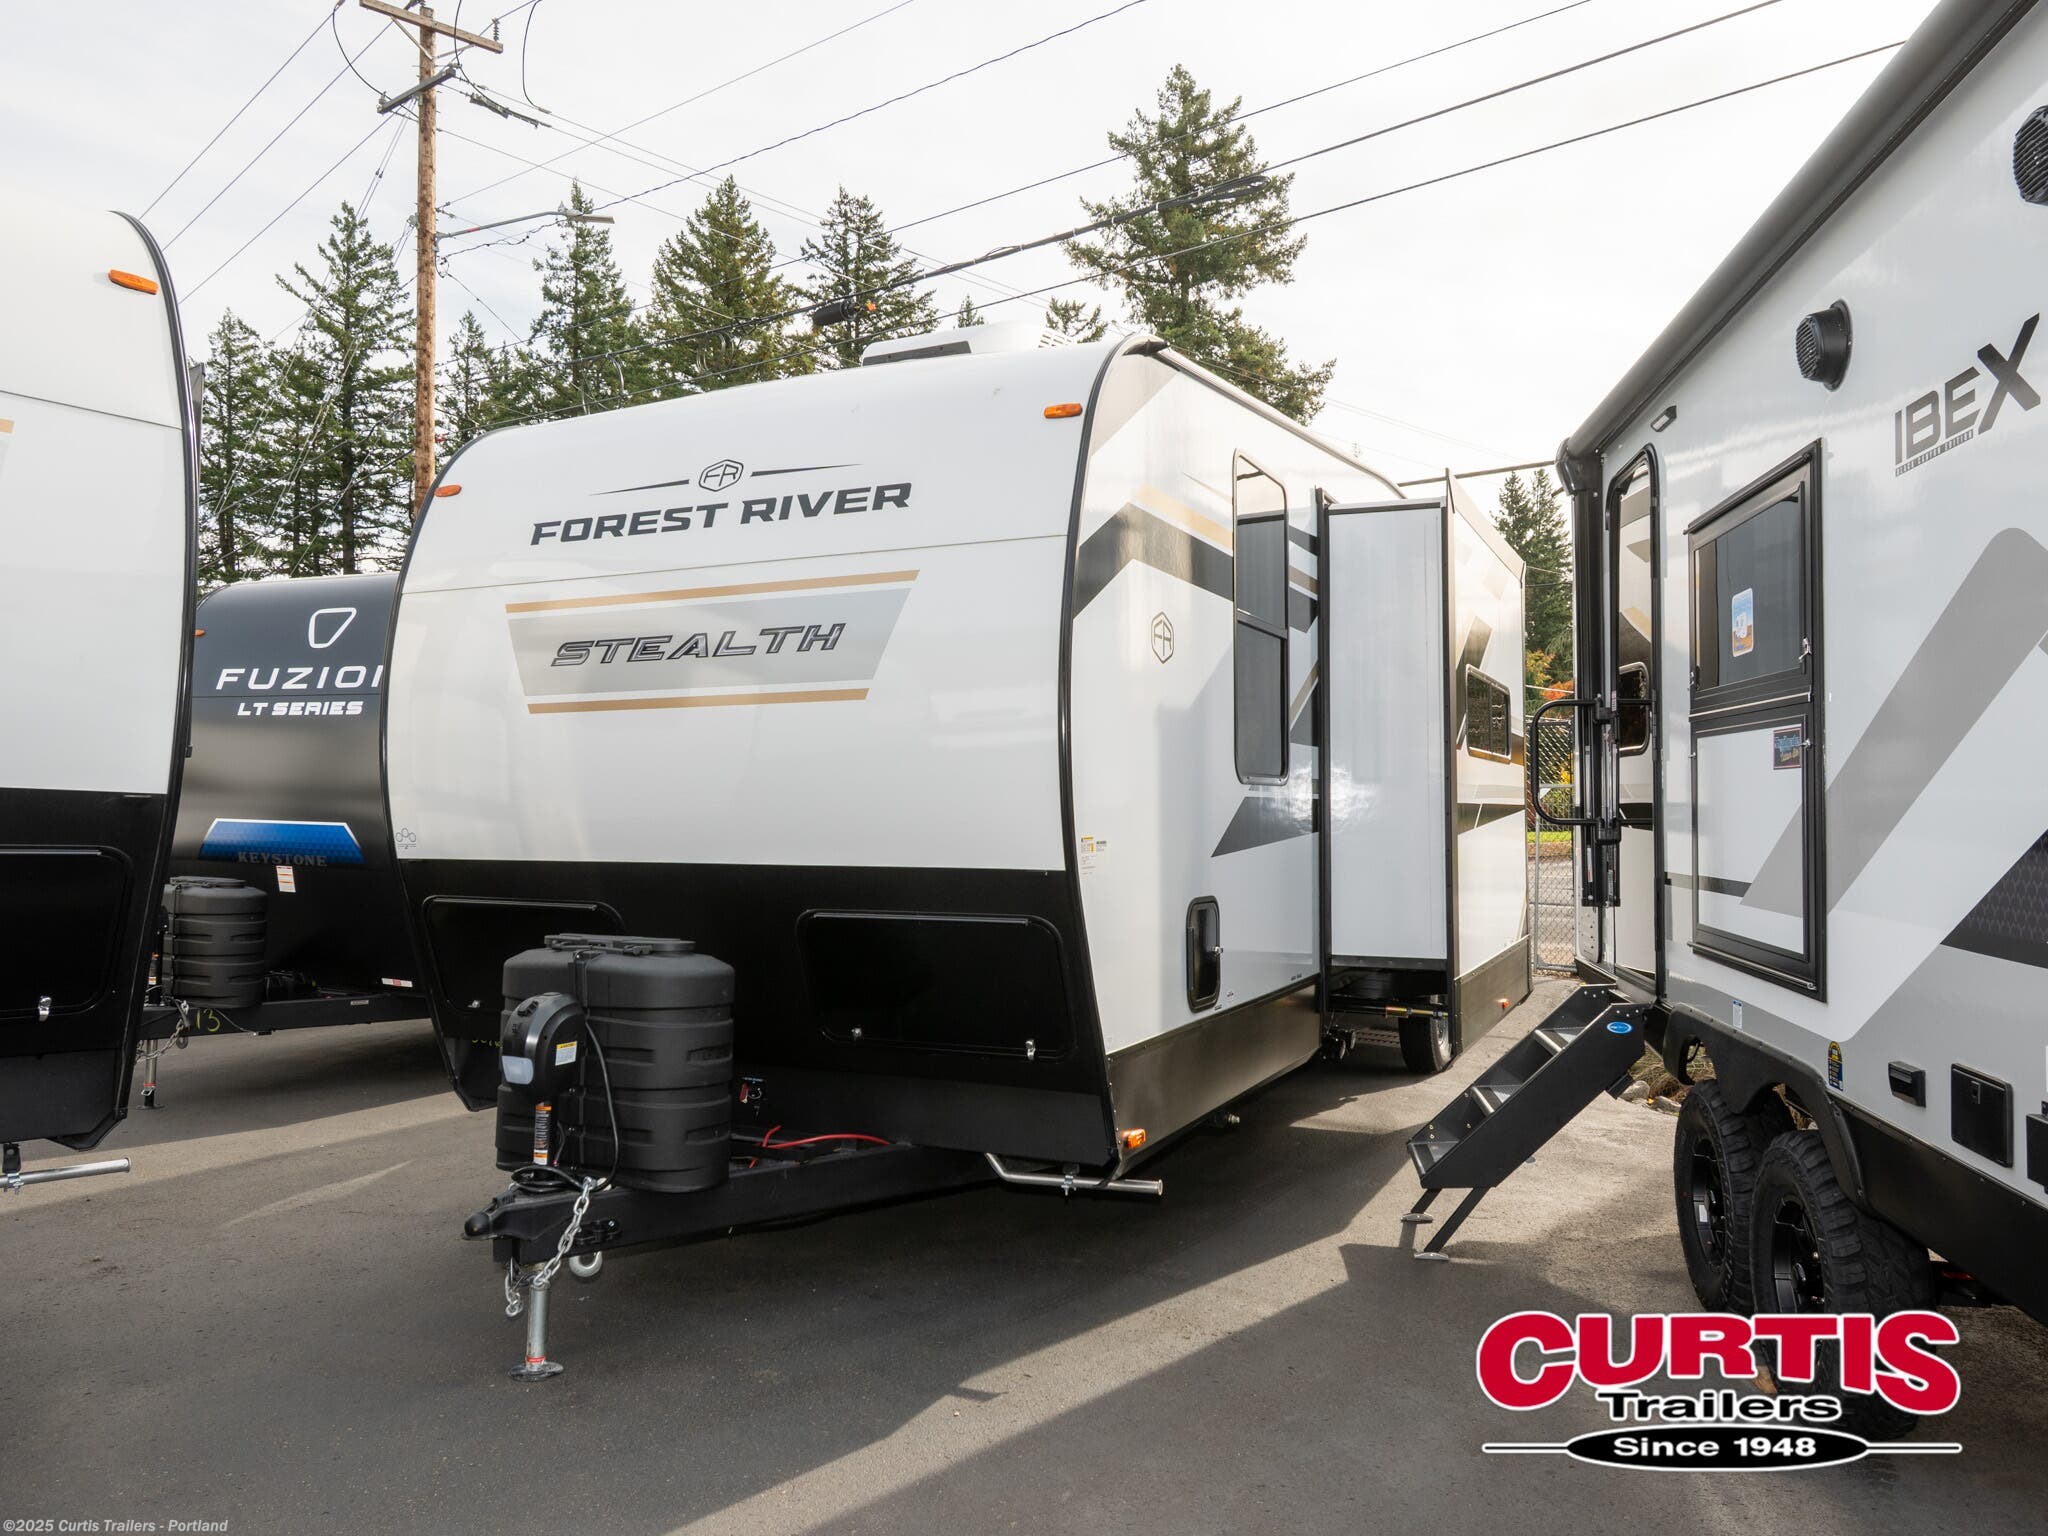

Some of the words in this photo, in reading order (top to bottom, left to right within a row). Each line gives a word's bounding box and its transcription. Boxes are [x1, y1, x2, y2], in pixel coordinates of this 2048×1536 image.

[1895, 312, 2041, 466] IBEX
[530, 502, 729, 546] FOREST
[740, 482, 912, 525] RIVER
[551, 622, 846, 667] STEALTH
[237, 702, 269, 716] LT
[271, 701, 364, 716] SERIES
[237, 851, 328, 867] KEYSTONE
